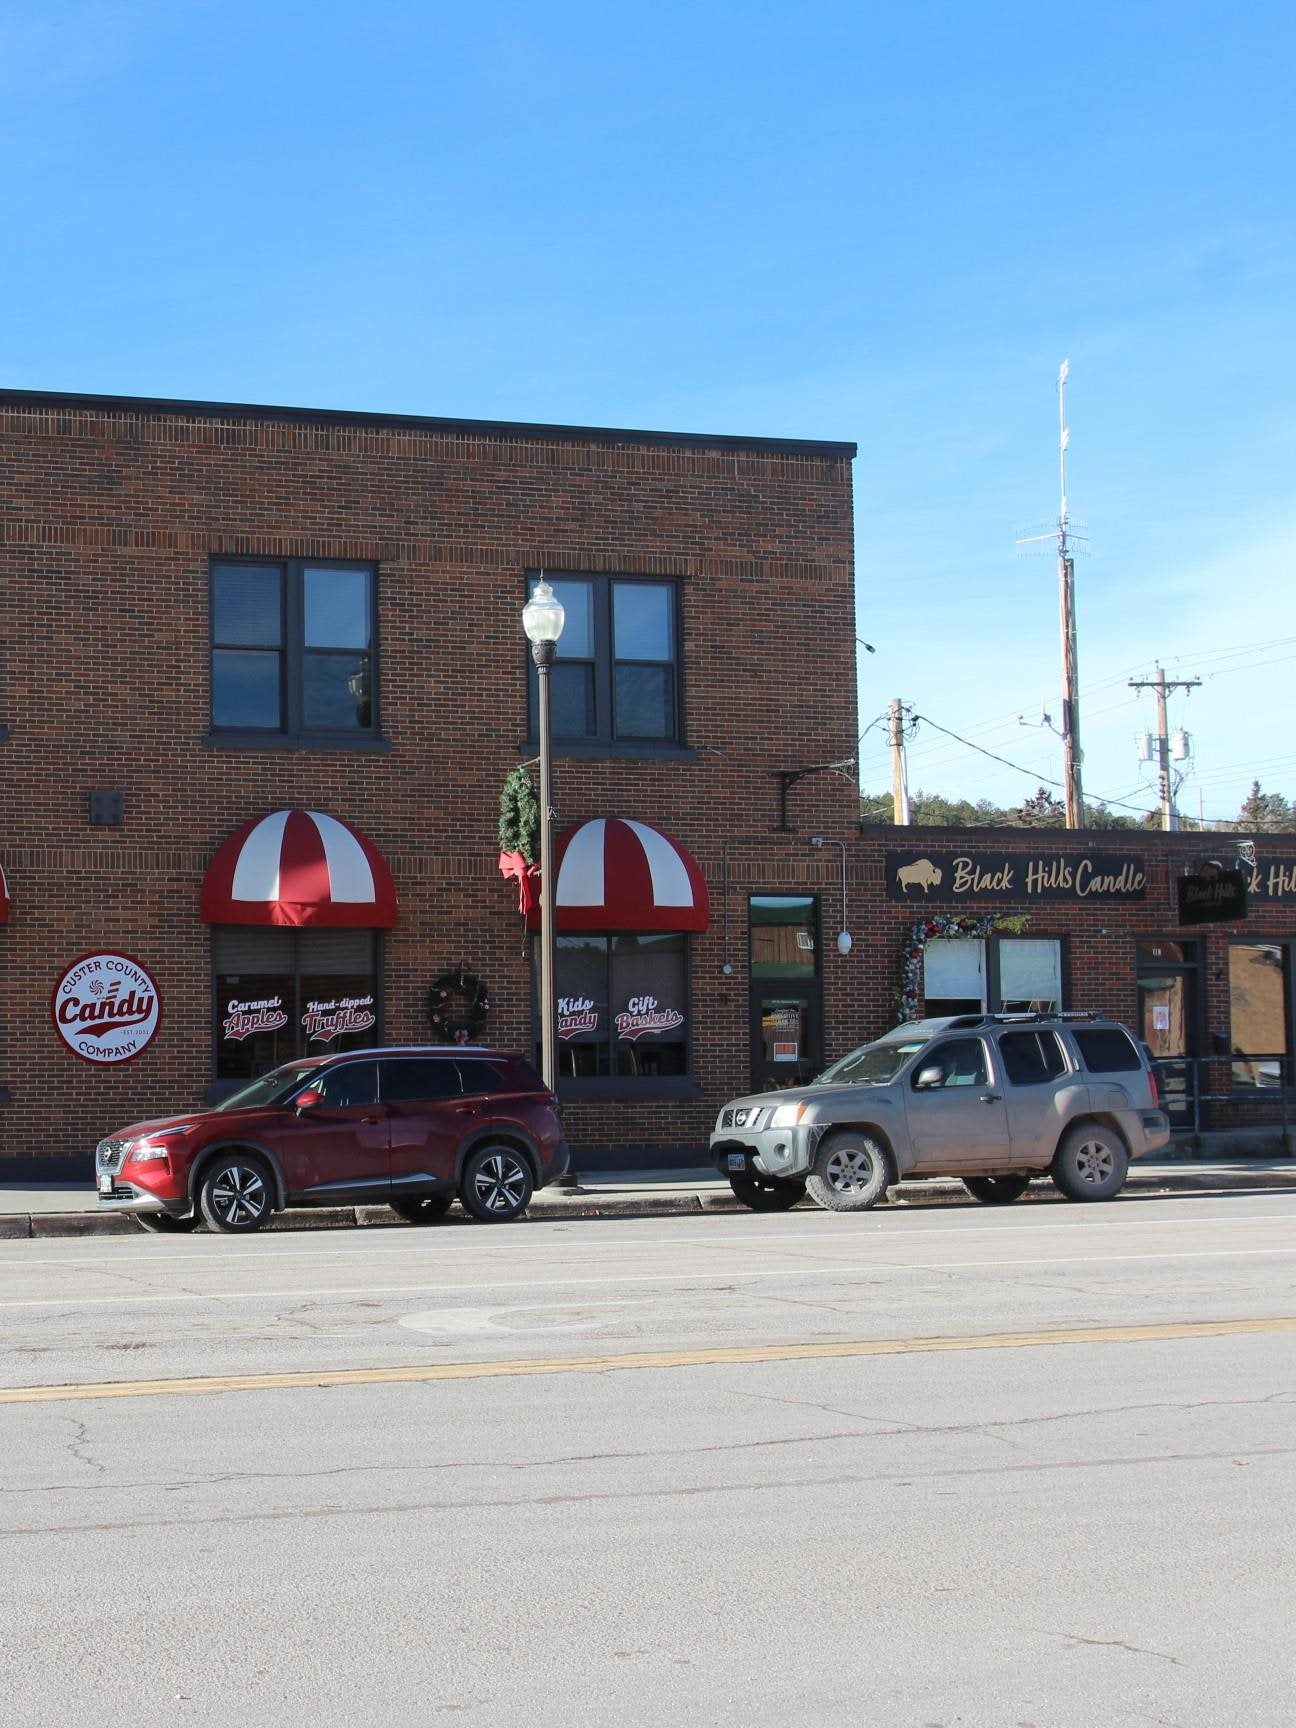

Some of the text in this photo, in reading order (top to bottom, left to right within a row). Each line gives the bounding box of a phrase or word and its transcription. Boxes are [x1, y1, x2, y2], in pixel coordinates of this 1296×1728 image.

[953, 857, 1146, 897] Black Hills Candle
[63, 960, 151, 994] CUSTER COUNTY
[58, 990, 155, 1025] Candy
[227, 995, 282, 1014] Caramel
[306, 994, 374, 1013] Hand-dipped
[557, 996, 594, 1015] Kids
[628, 995, 658, 1015] Gift
[222, 1008, 288, 1033] Apples
[301, 1009, 376, 1034] Truffles
[558, 1009, 599, 1032] andy
[614, 1008, 684, 1032] Baskets
[78, 1040, 138, 1058] COMPANY
